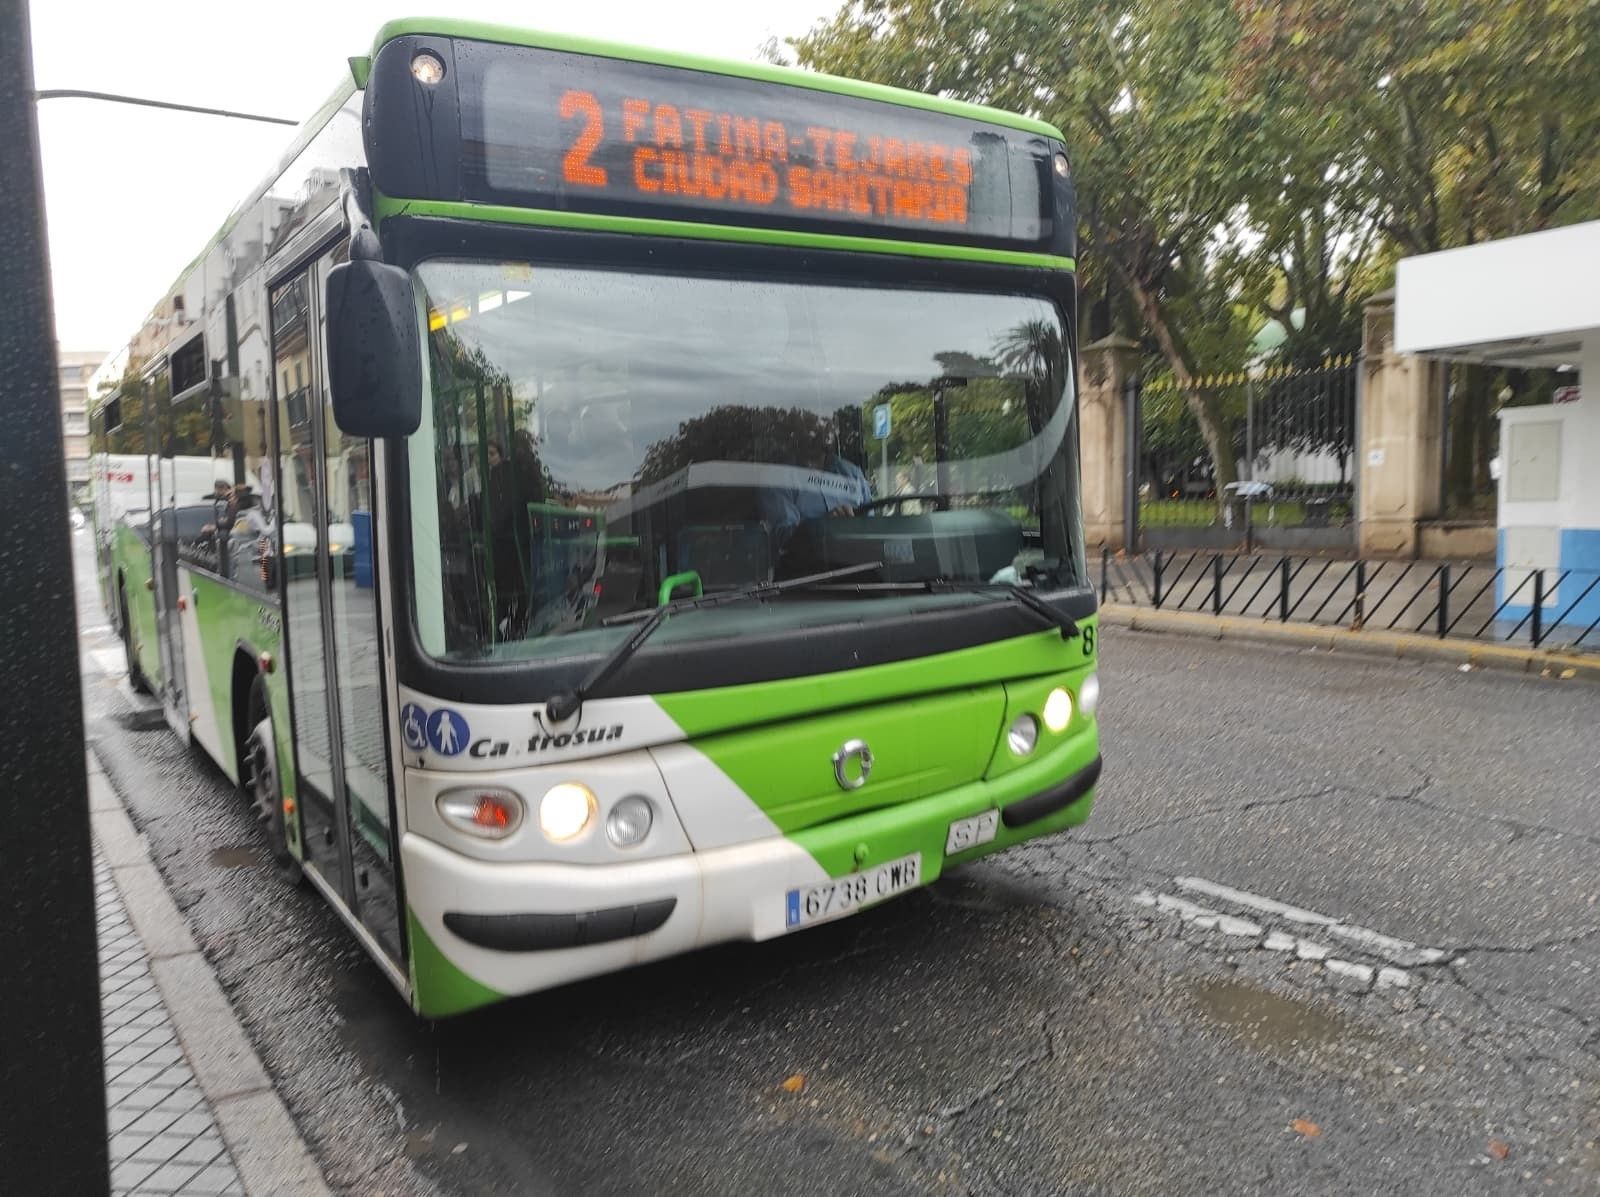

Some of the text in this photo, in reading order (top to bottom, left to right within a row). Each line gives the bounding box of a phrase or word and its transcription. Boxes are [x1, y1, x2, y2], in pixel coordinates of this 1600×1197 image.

[560, 89, 608, 188] 2
[633, 146, 968, 224] CIUDAD SANITARIA
[469, 723, 624, 759] Catrosua
[954, 813, 994, 849] SP
[805, 859, 917, 917] 6738 CWB
